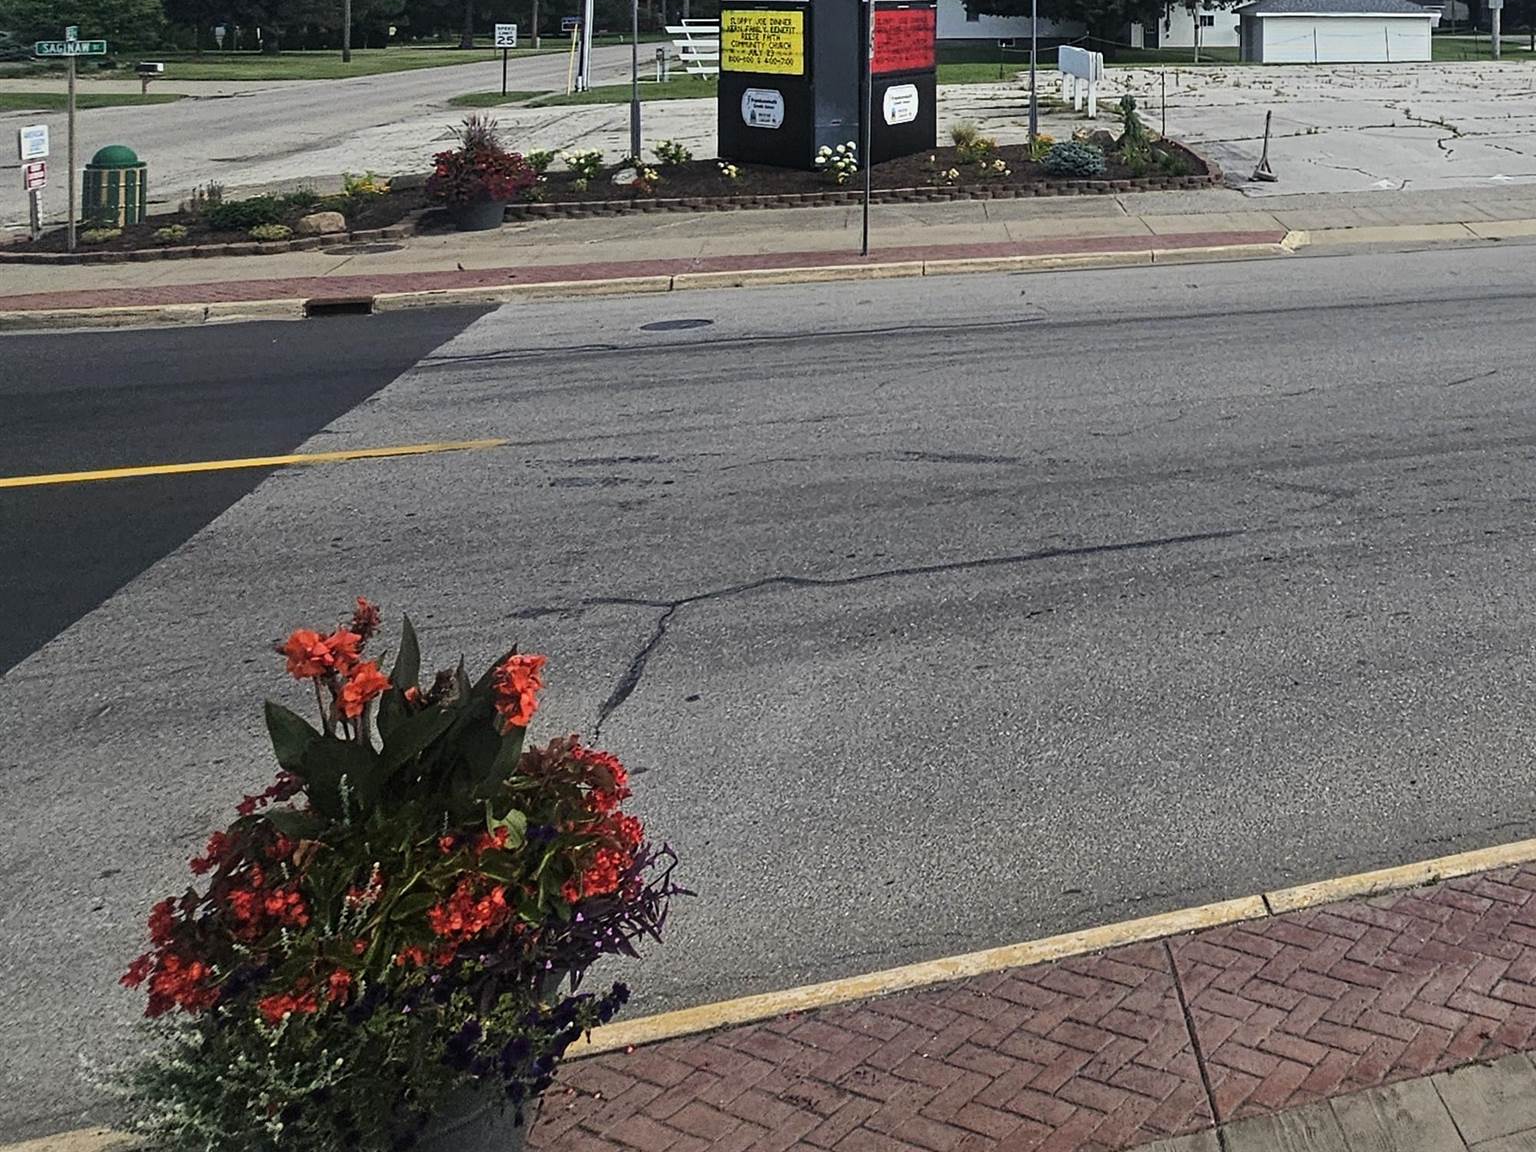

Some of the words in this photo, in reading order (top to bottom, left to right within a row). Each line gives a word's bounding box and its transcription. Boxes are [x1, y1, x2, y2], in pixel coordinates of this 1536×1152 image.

[756, 17, 767, 25] JOE
[497, 36, 514, 45] 25
[730, 40, 765, 48] COMMUNITY
[769, 41, 792, 49] CHURCH
[42, 43, 90, 53] SAGINAW
